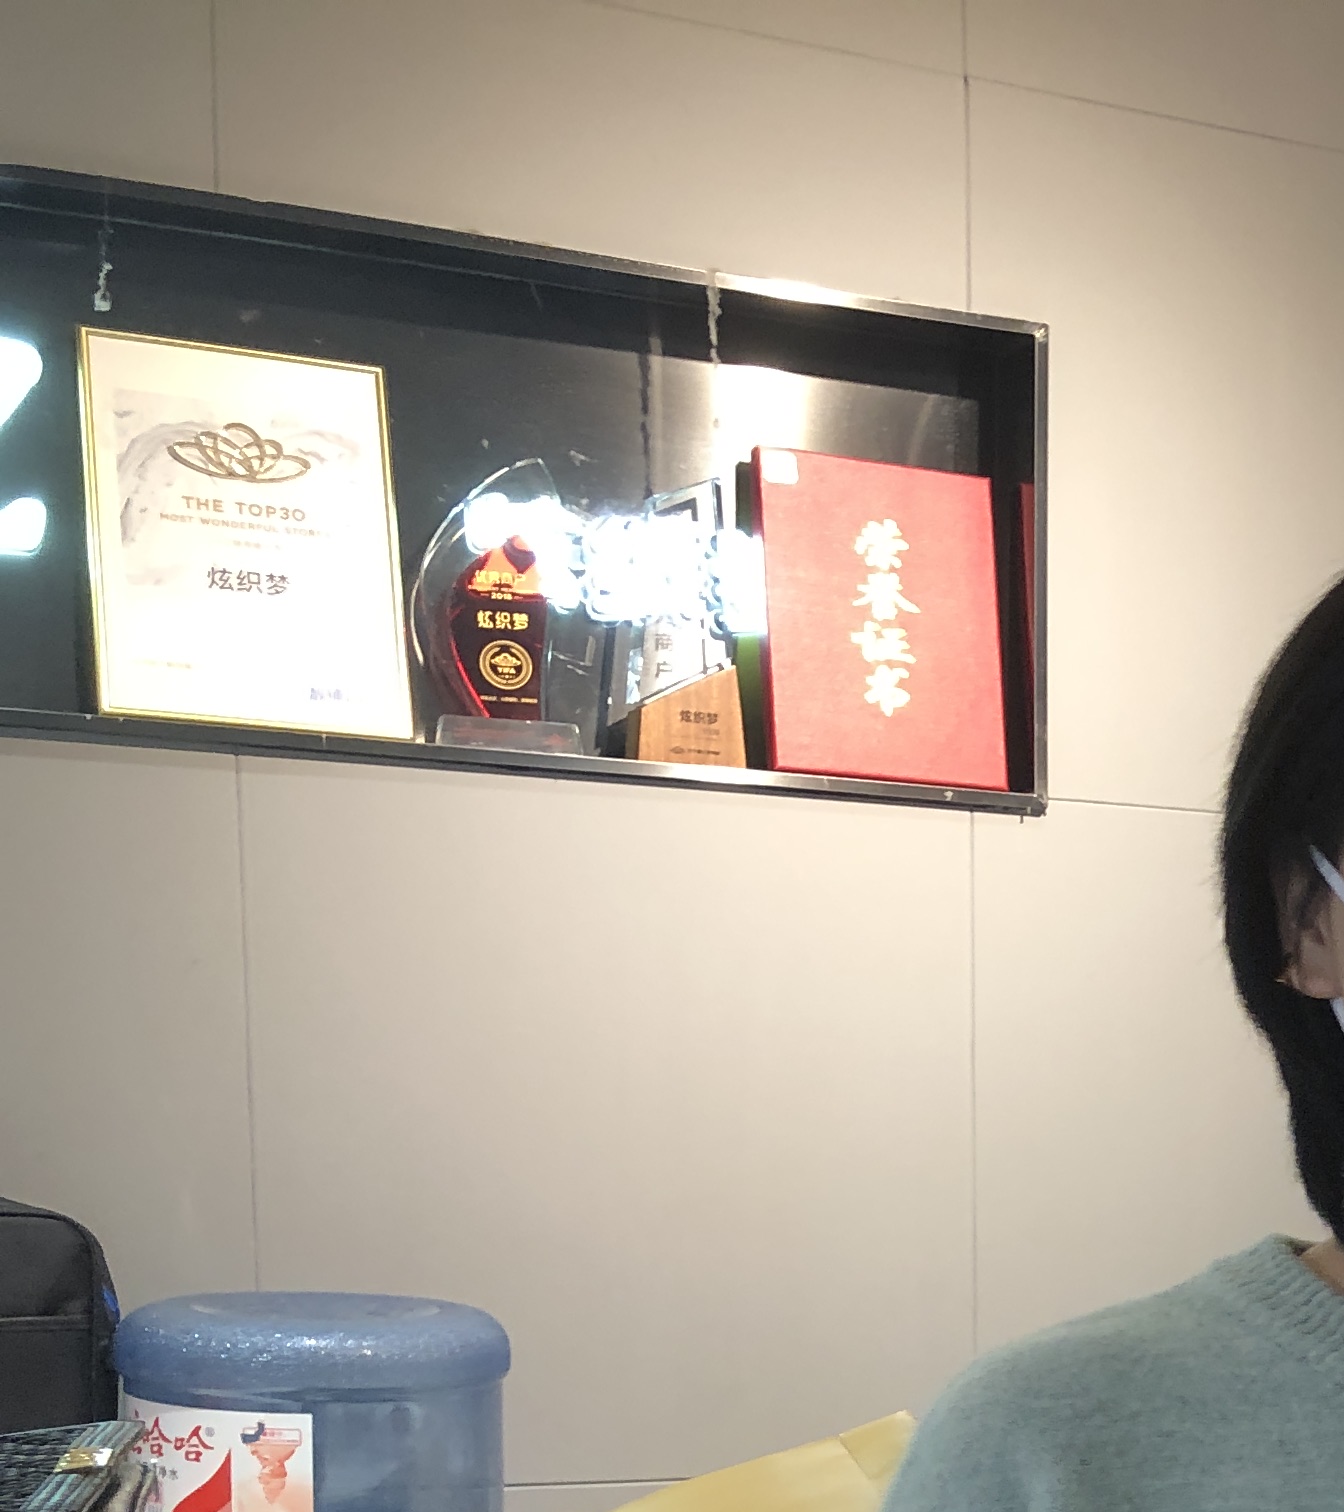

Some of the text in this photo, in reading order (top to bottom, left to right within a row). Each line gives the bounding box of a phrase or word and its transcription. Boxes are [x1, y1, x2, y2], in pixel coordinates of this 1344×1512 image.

[159, 511, 195, 524] MOST
[199, 516, 280, 534] WONDERFUL
[181, 494, 307, 523] THE TOP30
[206, 566, 291, 596] 炫织梦
[476, 609, 529, 631] 炫织梦
[131, 1409, 215, 1463] 哈哈
